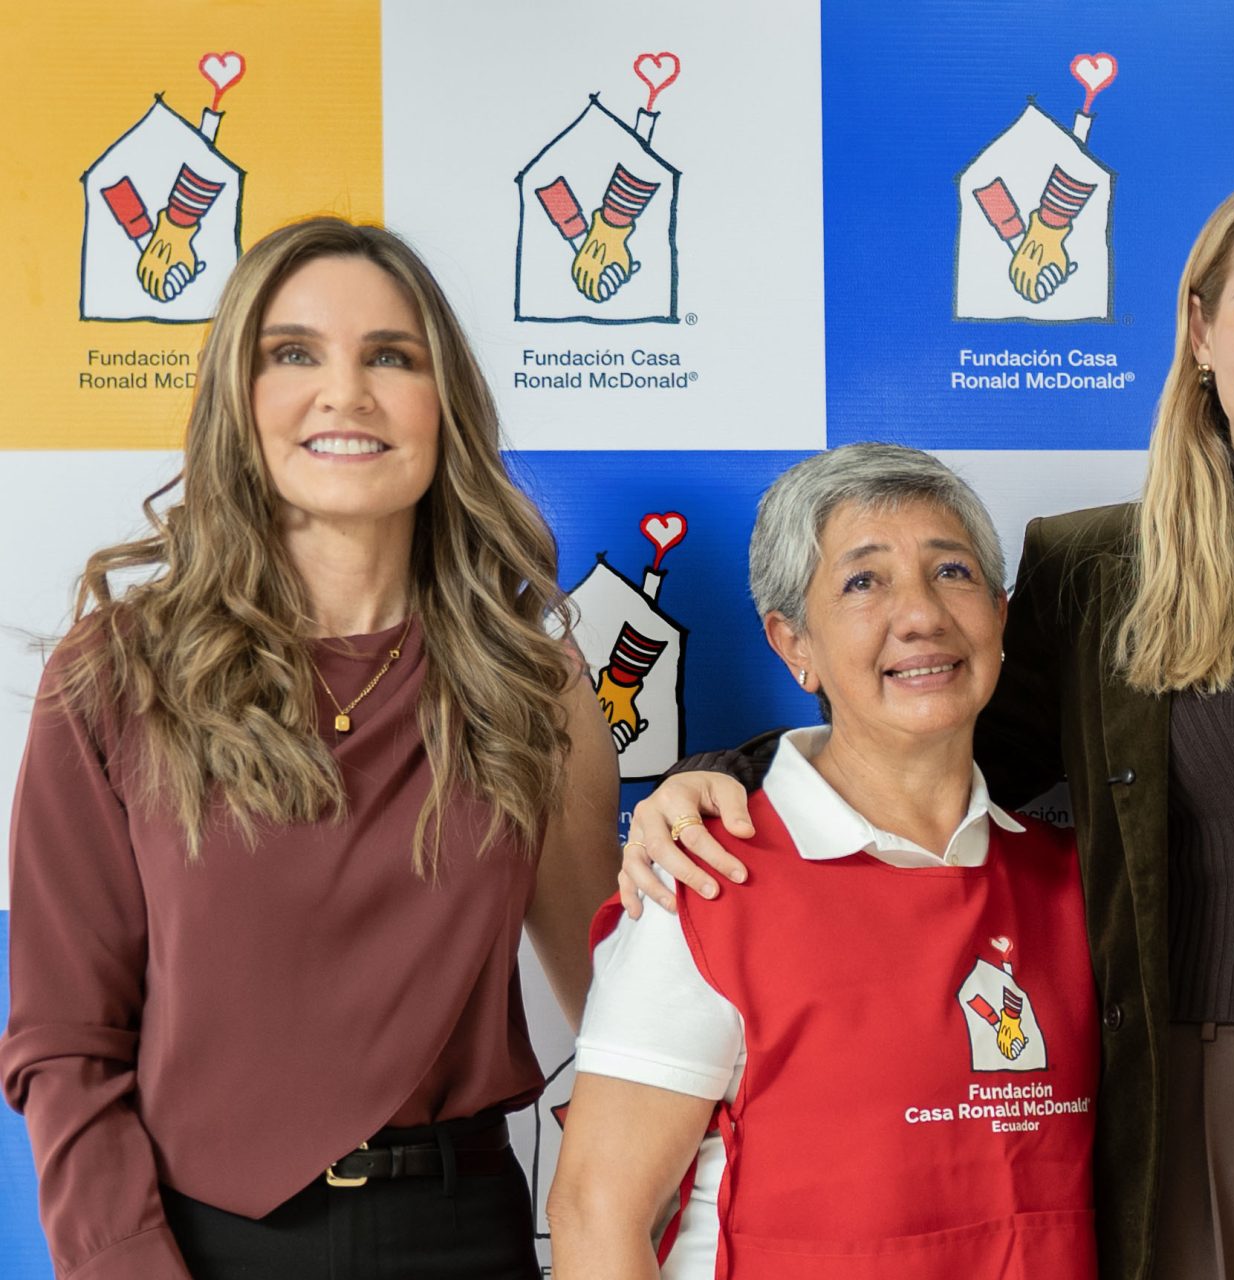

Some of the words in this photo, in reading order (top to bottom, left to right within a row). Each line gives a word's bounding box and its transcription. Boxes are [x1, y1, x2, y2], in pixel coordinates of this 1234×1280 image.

[88, 349, 190, 366] Fundación
[523, 349, 625, 366] Fundación
[631, 349, 681, 366] Casa
[960, 349, 1062, 367] Fundación
[1068, 349, 1118, 367] Casa
[79, 372, 147, 389] Ronald
[514, 372, 582, 389] Ronald
[951, 371, 1019, 389] Ronald
[969, 1082, 1053, 1100] Fundación
[905, 1107, 954, 1124] Casa
[958, 1101, 1020, 1120] Ronald
[992, 1120, 1040, 1133] Ecuador
